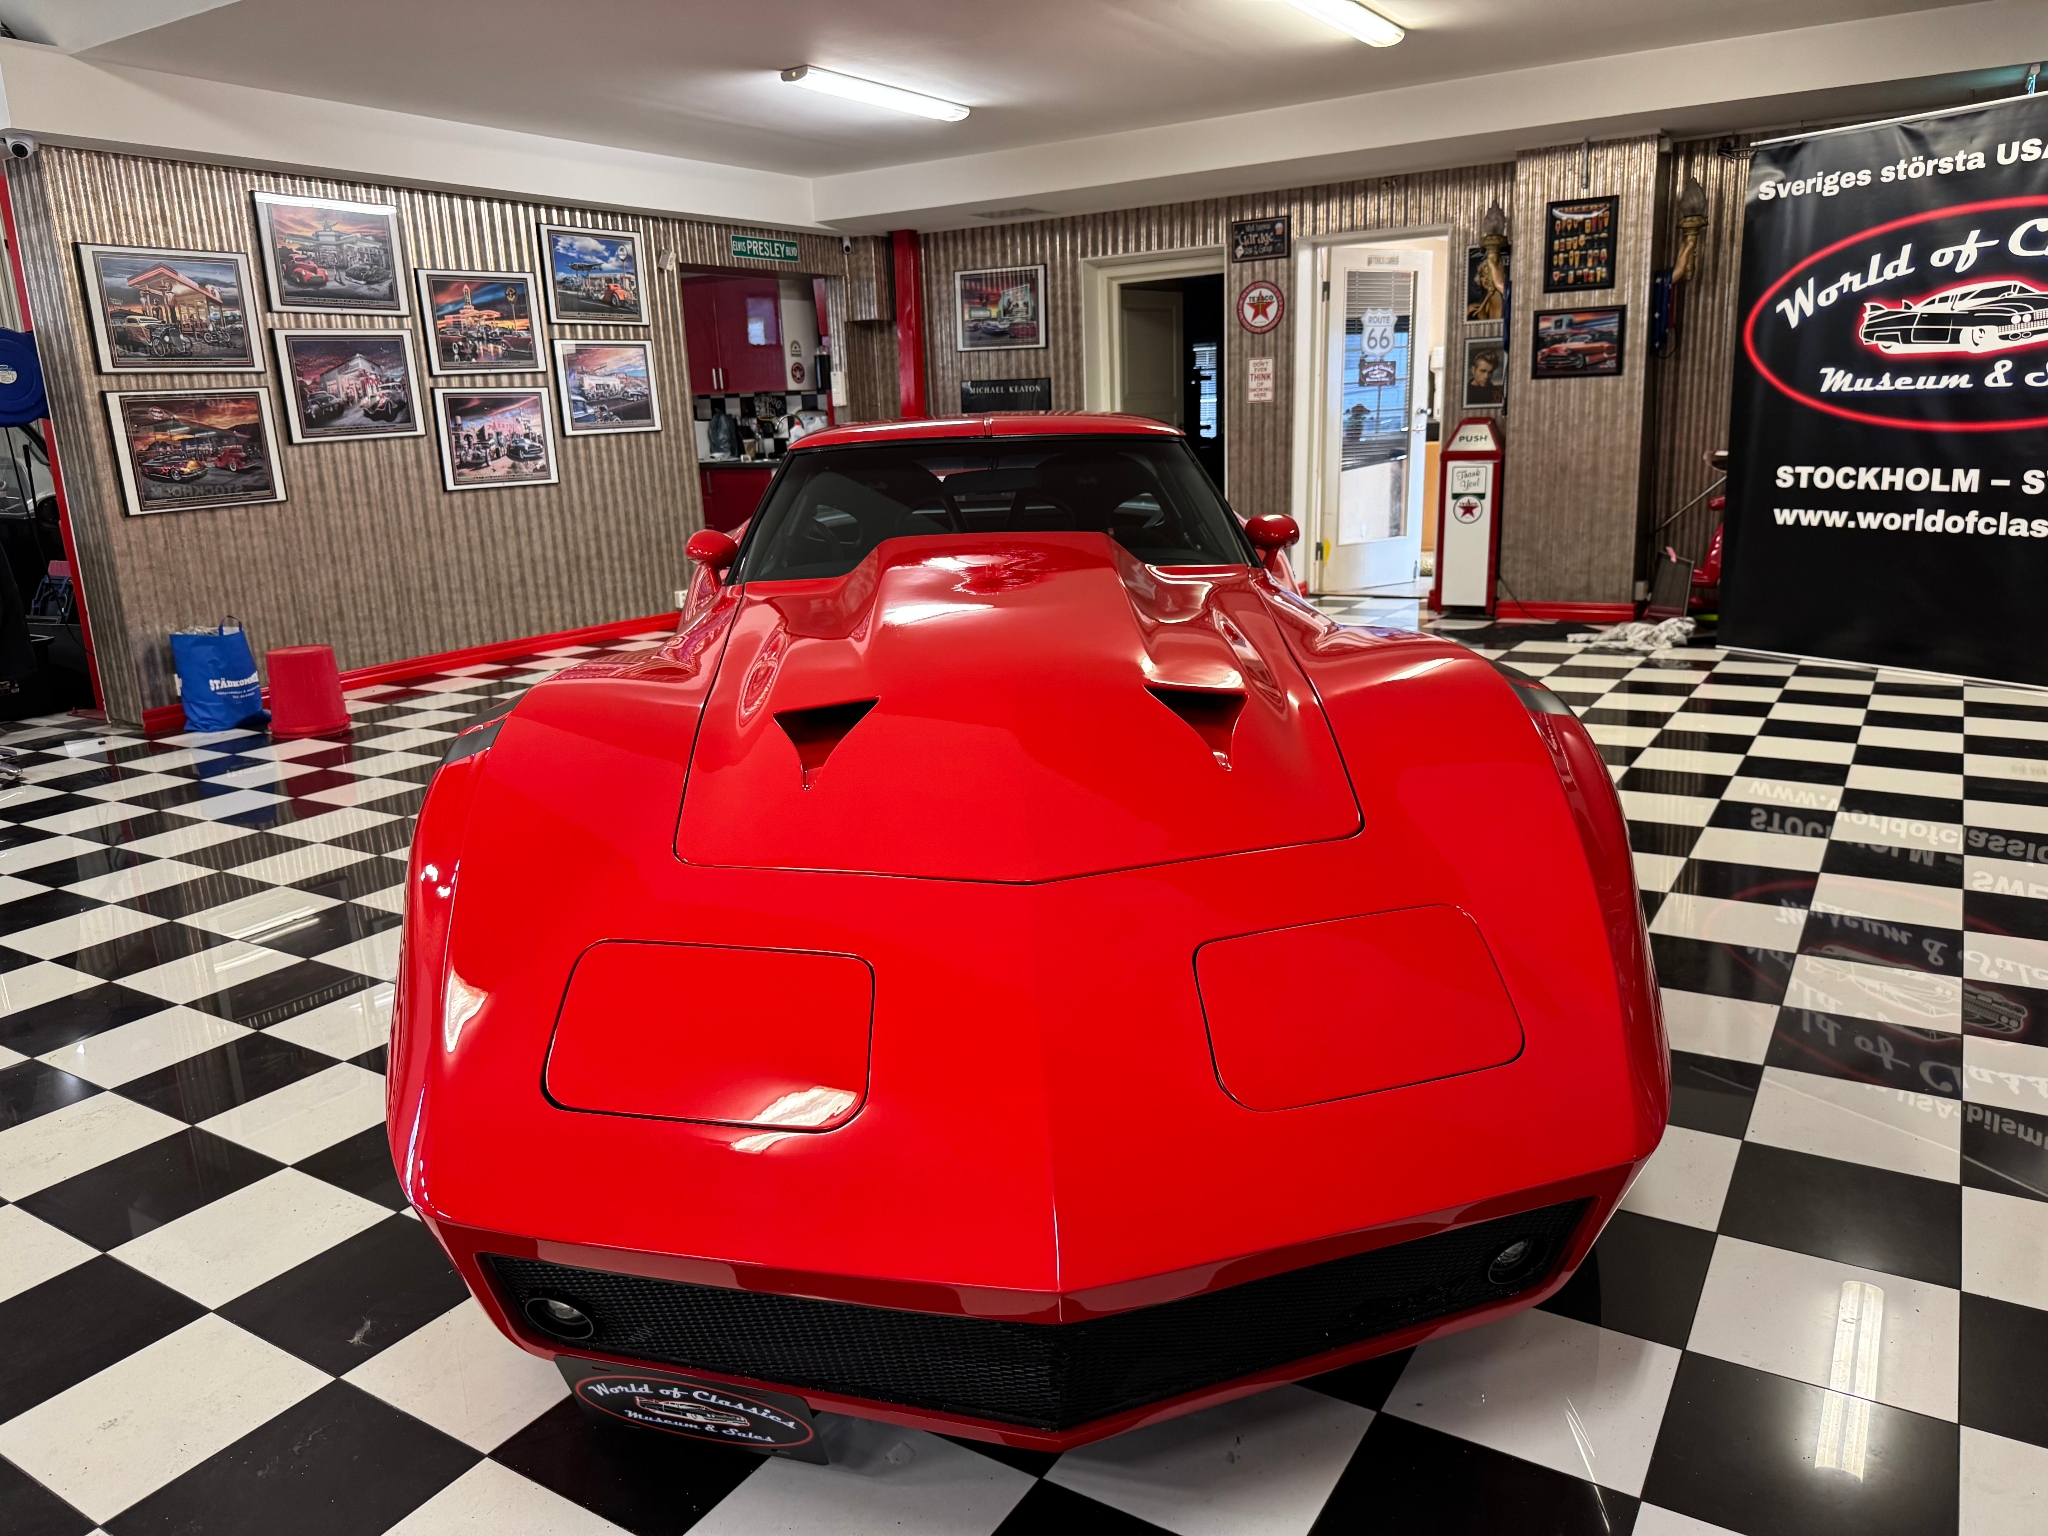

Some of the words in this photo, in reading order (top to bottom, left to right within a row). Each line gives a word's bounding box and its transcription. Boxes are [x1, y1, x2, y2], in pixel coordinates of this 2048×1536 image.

[1758, 169, 1872, 201] Sveriges
[1880, 149, 1986, 183] största
[733, 241, 746, 253] ELVIS
[746, 239, 785, 258] PRESLEY
[785, 246, 798, 257] BLVD
[1776, 243, 1916, 330] World
[1929, 229, 1999, 274] of
[2007, 217, 2048, 257] C
[1248, 294, 1274, 303] TEXACO
[1368, 315, 1391, 325] ROUTE
[1366, 328, 1390, 350] 66
[1250, 373, 1271, 382] THINK
[1819, 367, 1974, 393] Museum
[1984, 359, 2014, 388] &
[970, 386, 1005, 394] MICHAEL
[1009, 385, 1041, 393] KEATON
[1458, 435, 1488, 443] PUSH
[1456, 469, 1481, 481] Thank
[1460, 477, 1480, 491] You!
[1775, 465, 1981, 493] STOCKHOLM
[2021, 469, 2048, 495] S
[1773, 508, 2048, 538] www.worldofclas
[588, 1382, 653, 1397] World
[658, 1387, 689, 1398] of
[692, 1390, 797, 1430] Classics
[624, 1409, 701, 1430] Museum
[704, 1424, 719, 1433] &
[721, 1428, 776, 1443] Sales
